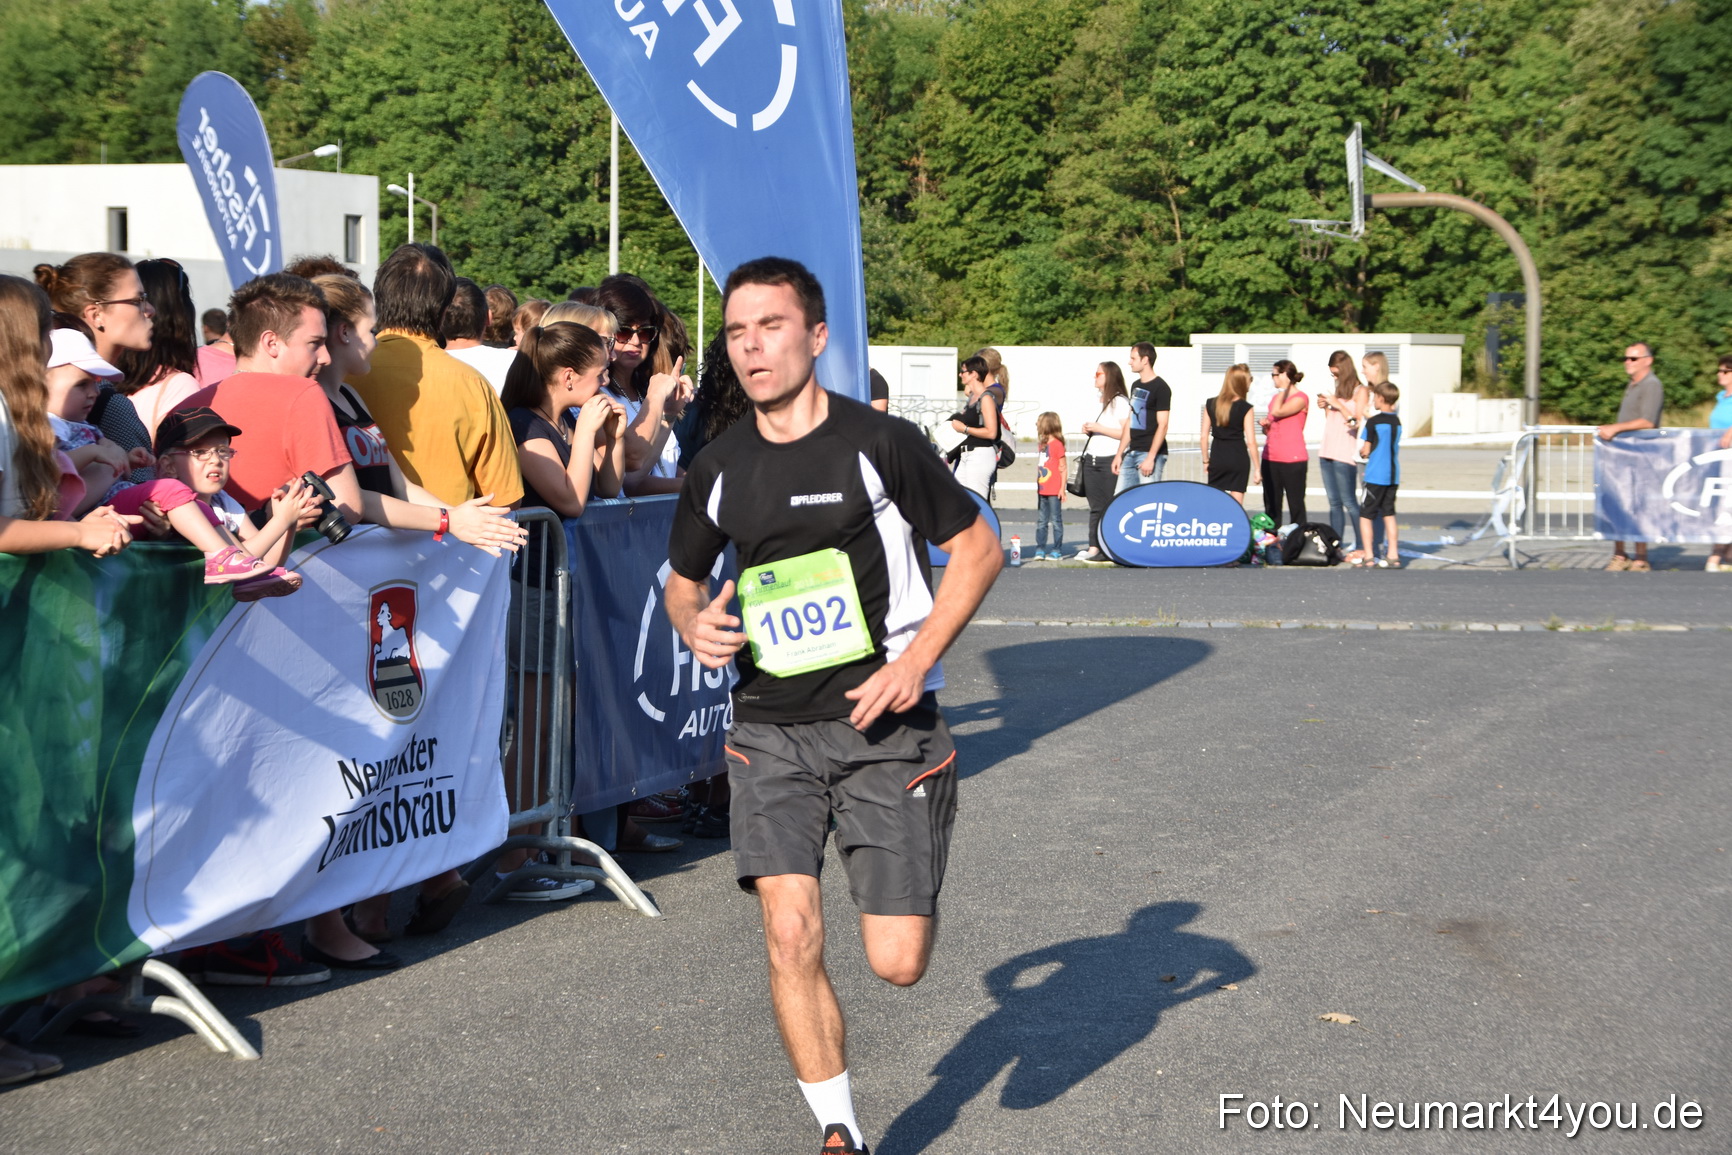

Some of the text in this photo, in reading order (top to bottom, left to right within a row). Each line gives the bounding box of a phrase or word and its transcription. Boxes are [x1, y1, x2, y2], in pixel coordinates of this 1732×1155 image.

[1141, 518, 1233, 538] Fischer
[1151, 538, 1227, 547] AUTOMOBILE
[760, 595, 852, 645] 1092
[385, 688, 415, 710] 1628
